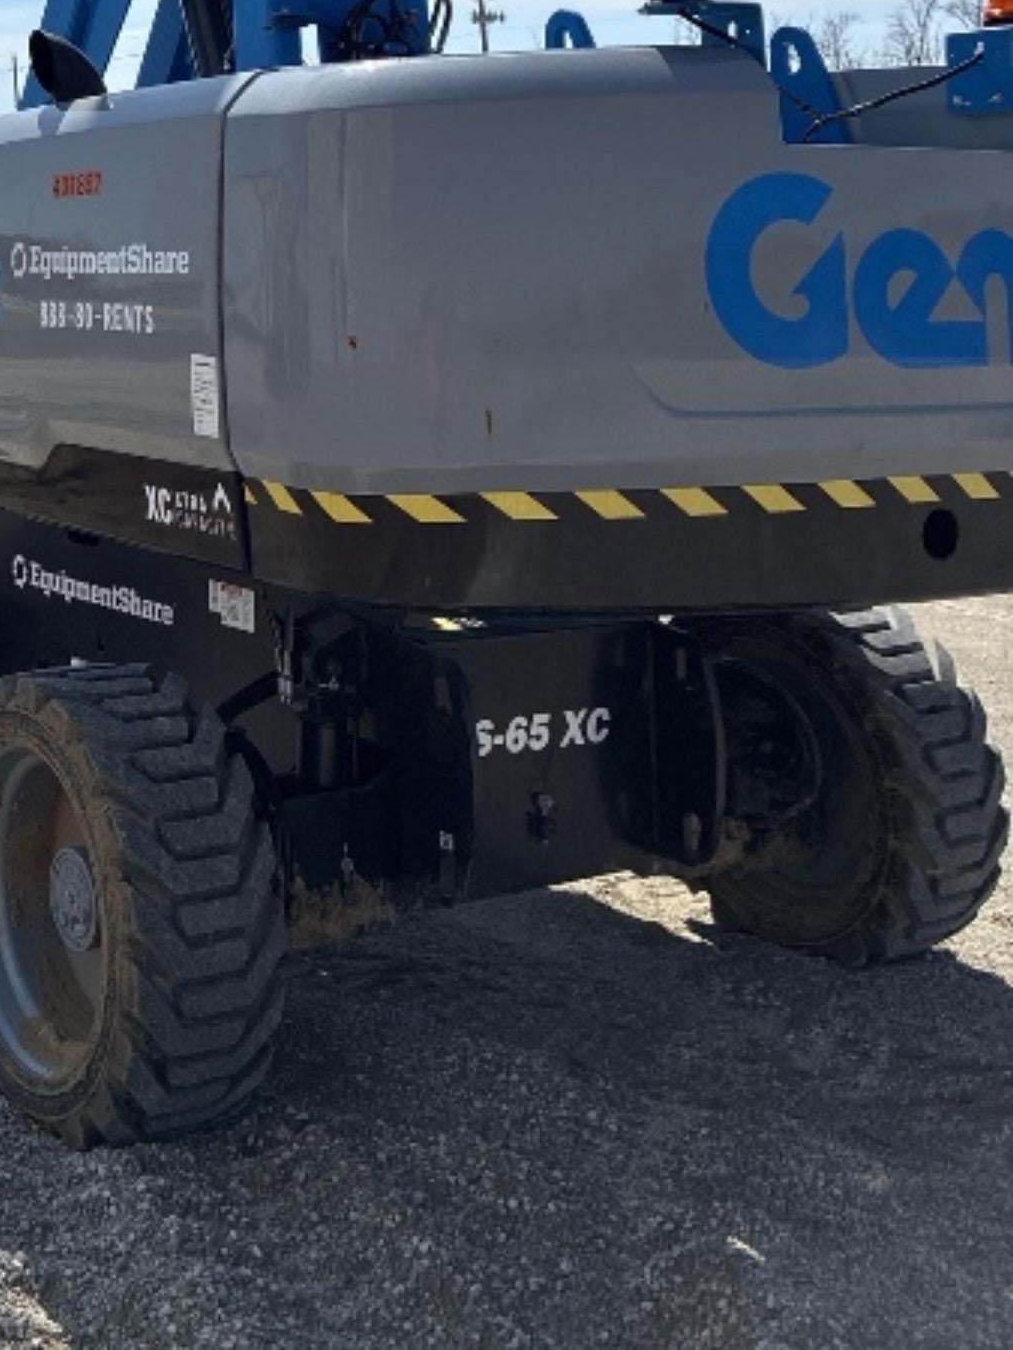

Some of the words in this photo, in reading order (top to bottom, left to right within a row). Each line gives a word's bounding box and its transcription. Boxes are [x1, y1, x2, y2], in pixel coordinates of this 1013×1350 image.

[28, 244, 189, 280] EquipmentShare
[30, 559, 175, 625] EquipmentShare
[475, 712, 553, 758] S-65
[558, 706, 611, 749] XC
